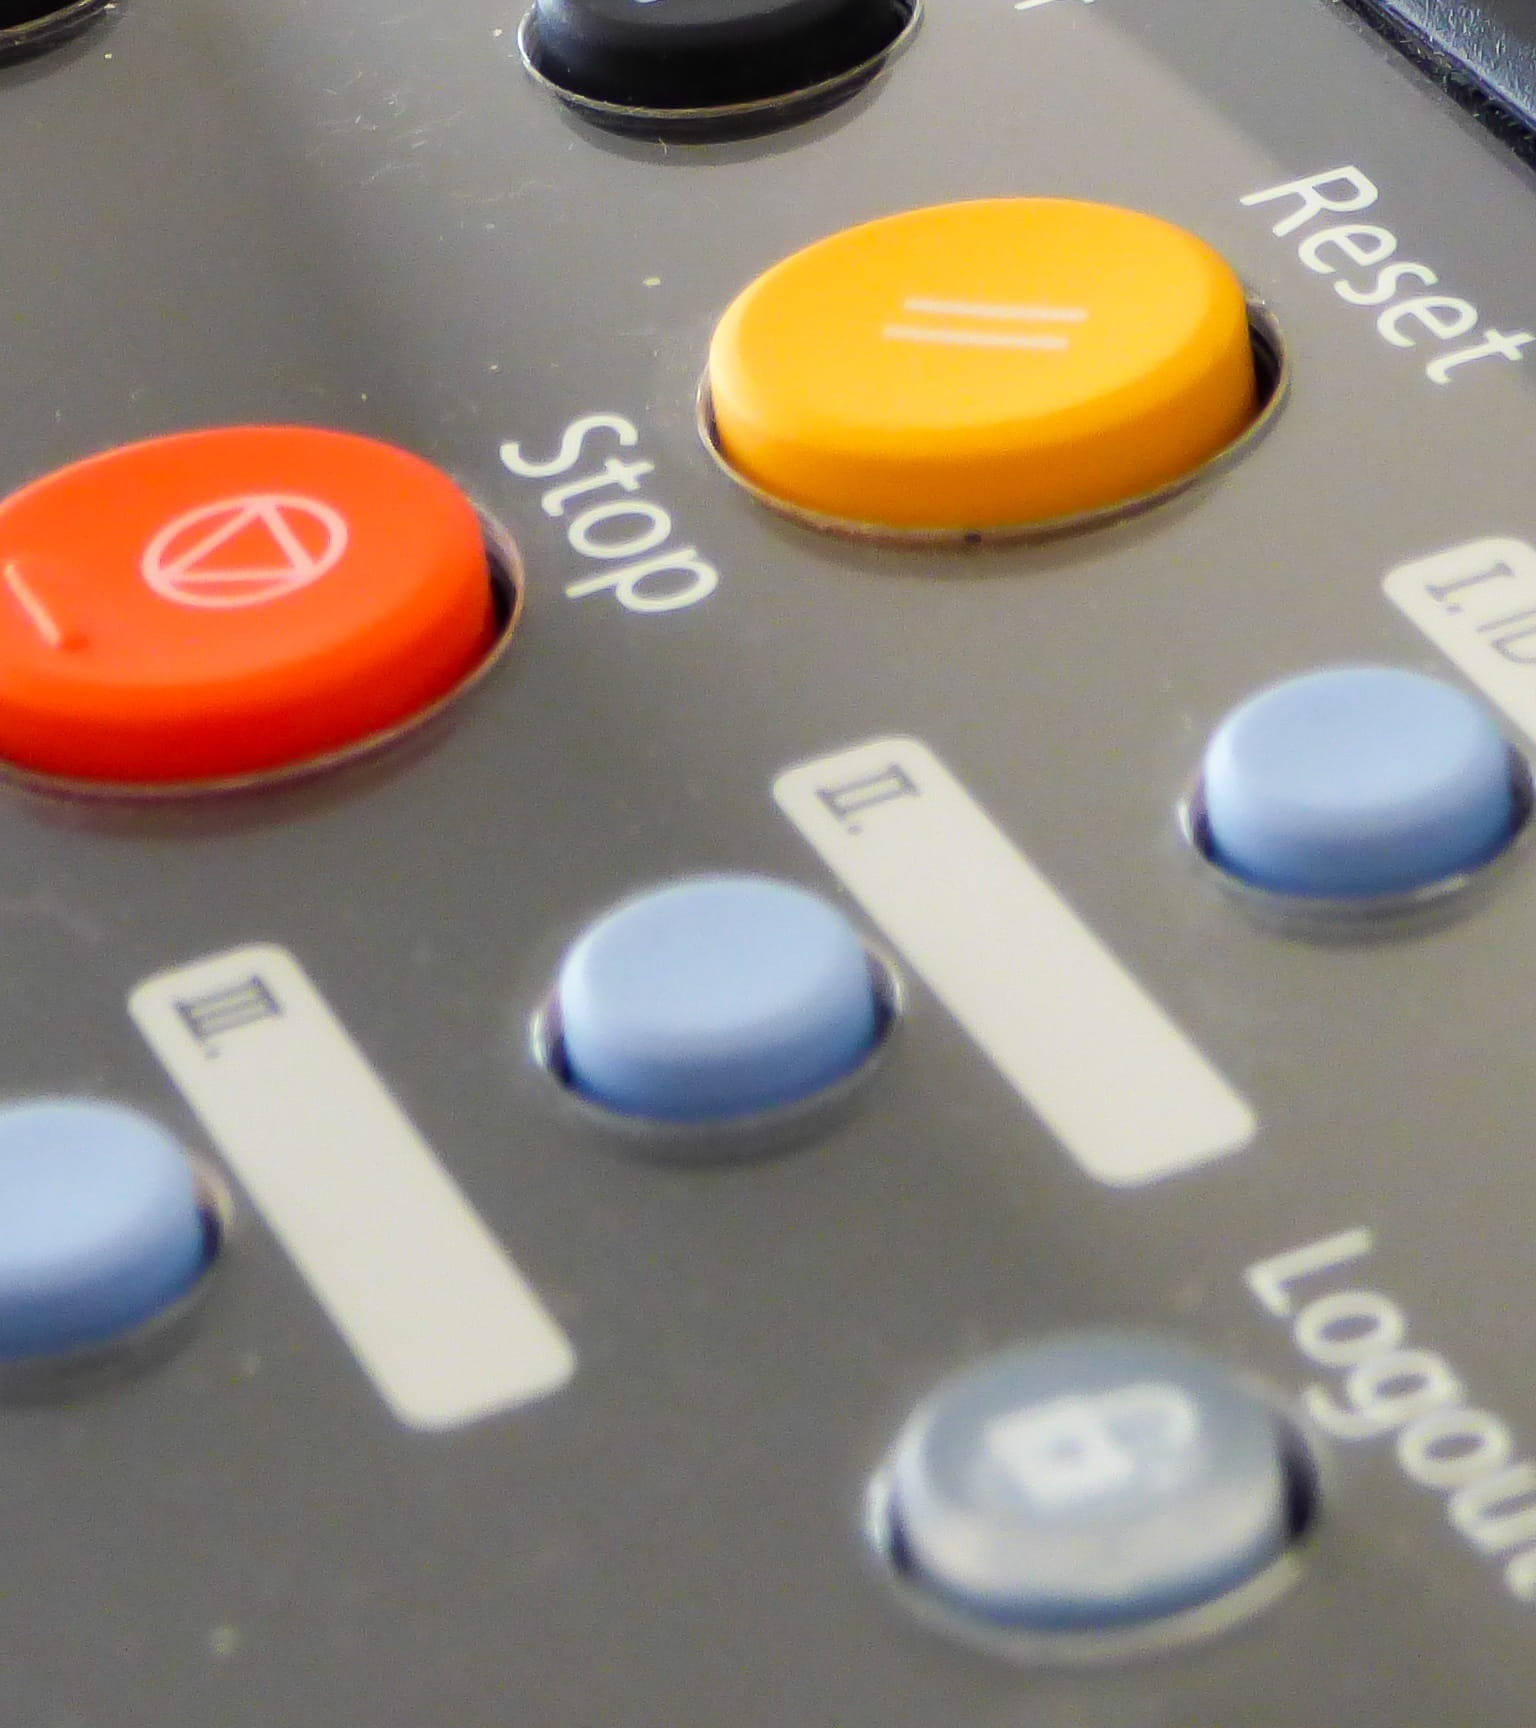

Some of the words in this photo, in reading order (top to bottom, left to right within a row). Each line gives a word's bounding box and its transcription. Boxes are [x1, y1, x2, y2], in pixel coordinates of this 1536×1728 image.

[1239, 165, 1535, 384] Reset
[499, 413, 719, 613] Stop
[1426, 559, 1513, 614] I.
